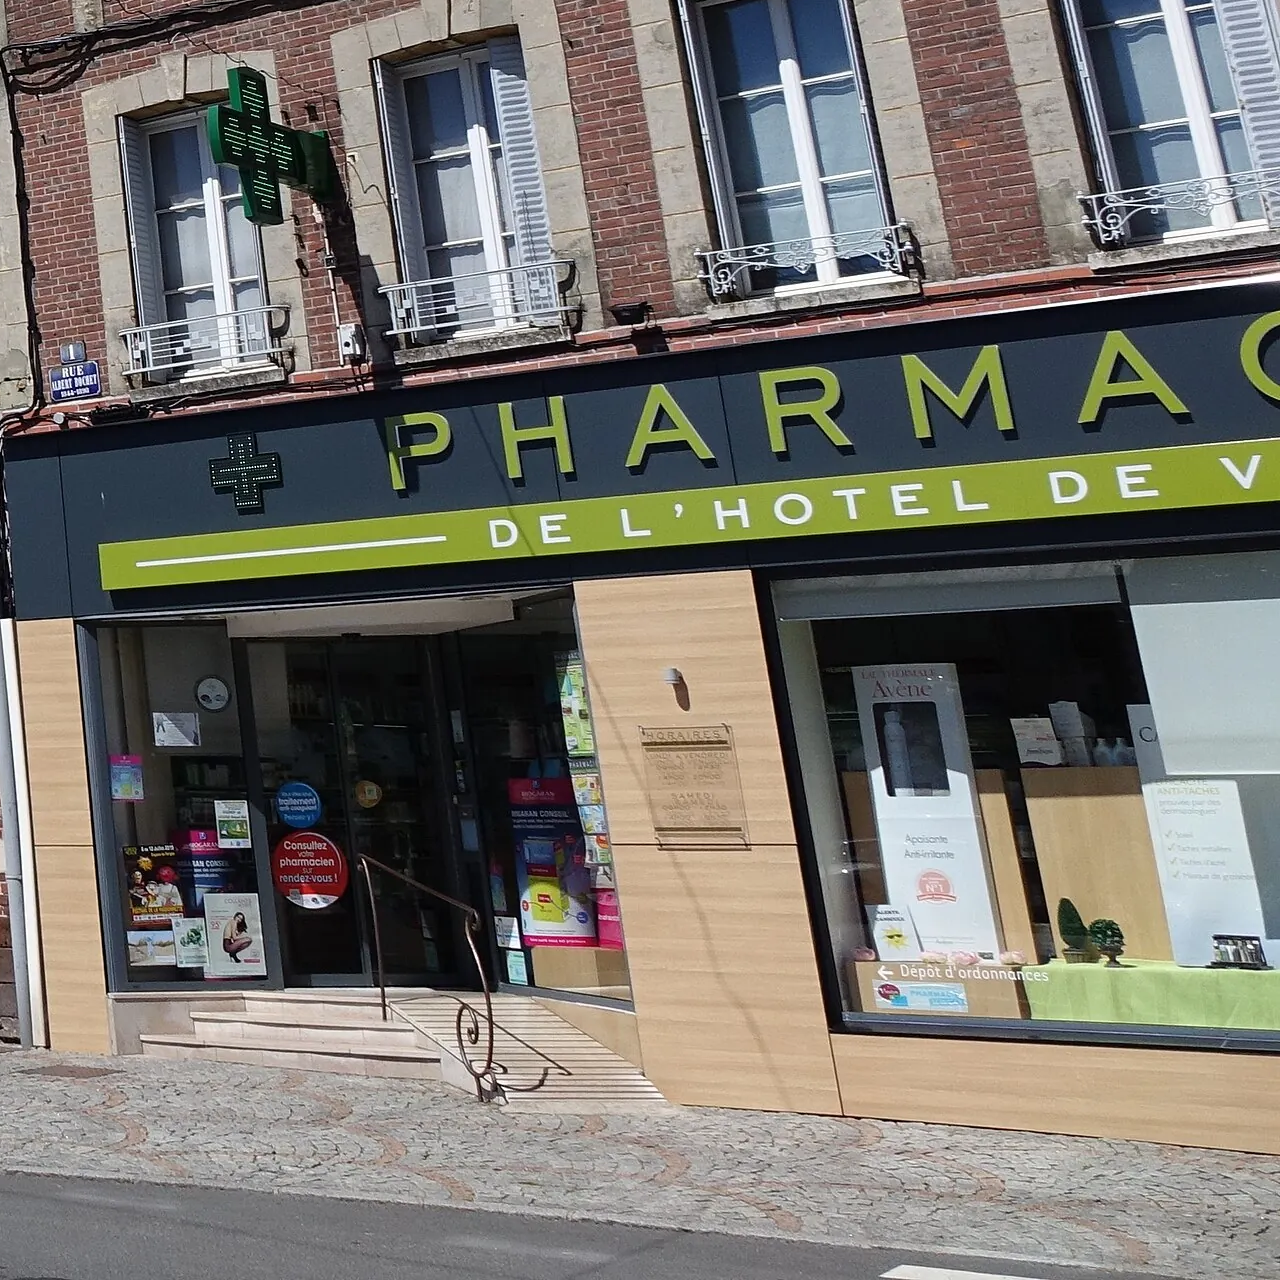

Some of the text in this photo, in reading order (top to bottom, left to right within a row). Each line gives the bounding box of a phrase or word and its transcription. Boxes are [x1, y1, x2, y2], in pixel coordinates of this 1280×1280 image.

[62, 365, 84, 378] RUE
[488, 513, 572, 548] DE
[619, 480, 989, 539] L'HOTEL
[1048, 464, 1160, 505] DE
[872, 680, 933, 698] Avène
[646, 730, 721, 740] HORAIRES
[905, 833, 948, 846] Apaisante
[283, 841, 327, 850] Consultez
[904, 849, 955, 859] Anti-irritante
[279, 858, 335, 868] pharmacien
[279, 874, 332, 882] rendez-vous
[900, 964, 1049, 982] Dépôt d'ordonnances
